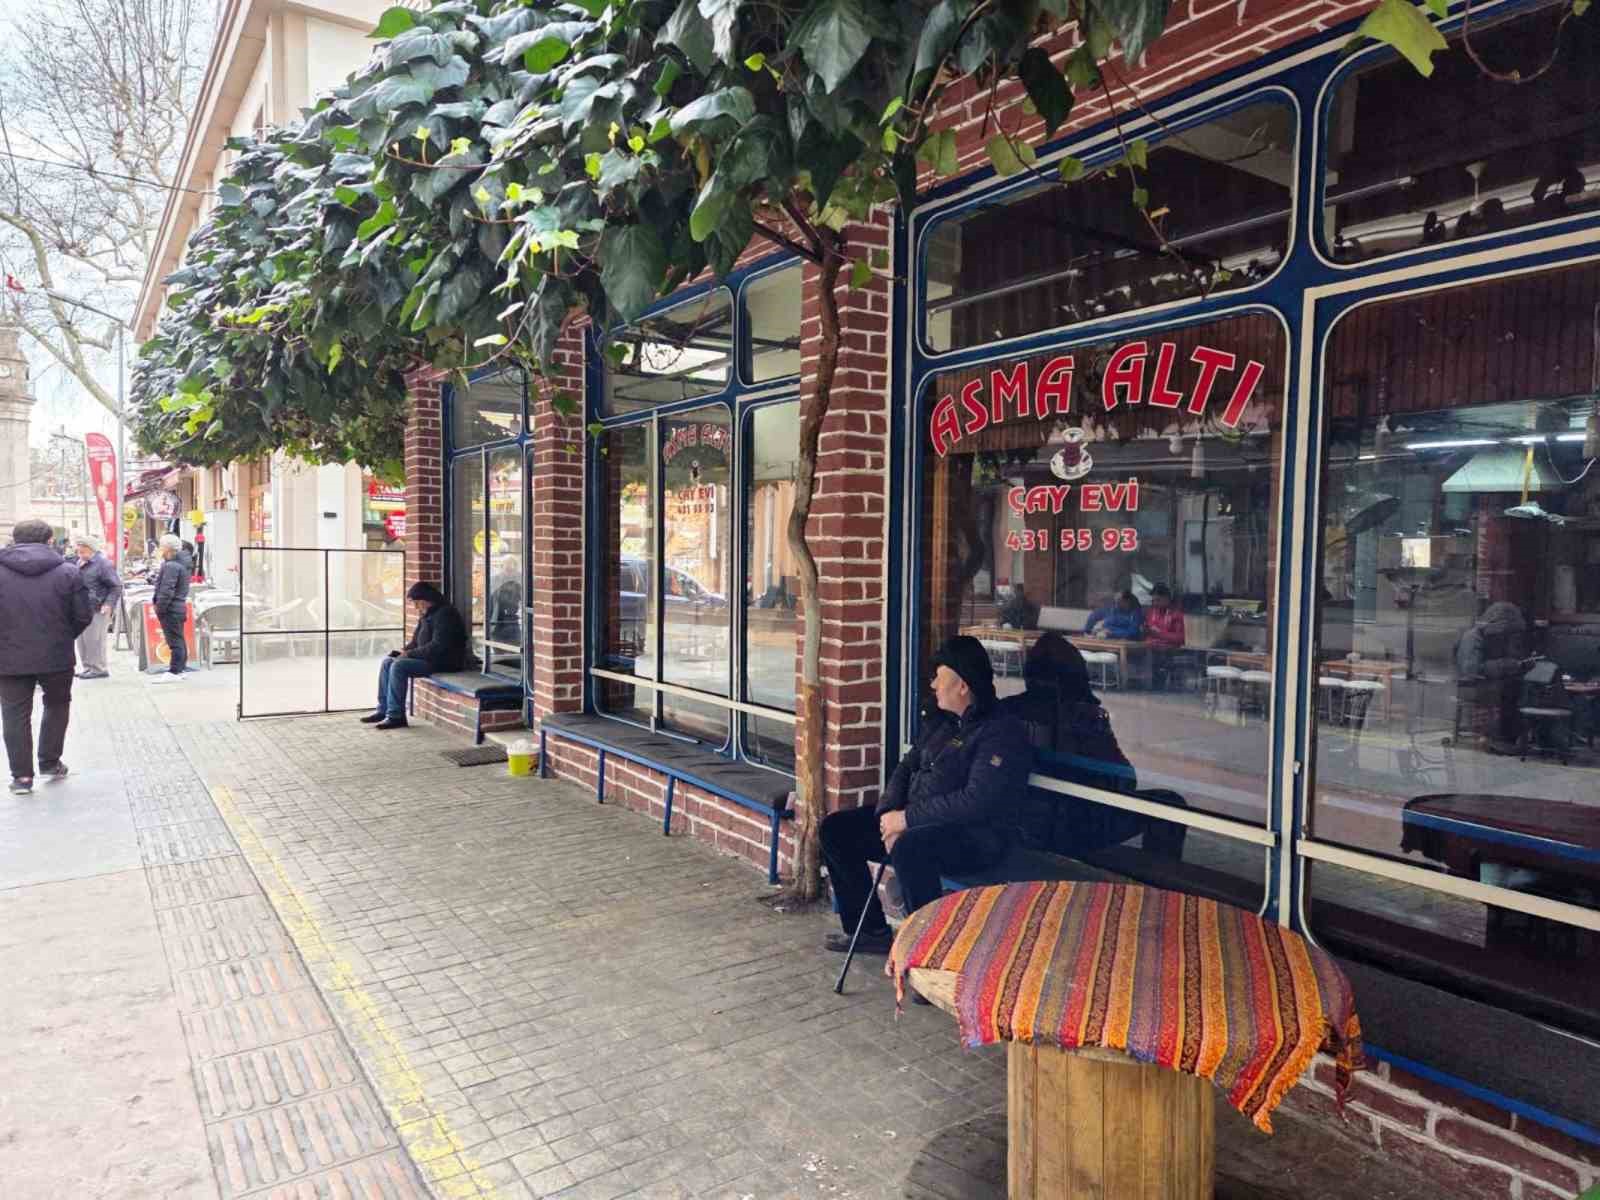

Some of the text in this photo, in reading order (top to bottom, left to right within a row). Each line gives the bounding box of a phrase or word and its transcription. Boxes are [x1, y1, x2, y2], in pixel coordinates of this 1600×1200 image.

[930, 341, 1265, 458] ASMA ALTI
[1007, 477, 1139, 518] ÇAY EVİ
[1005, 527, 1138, 551] 431 55 93
